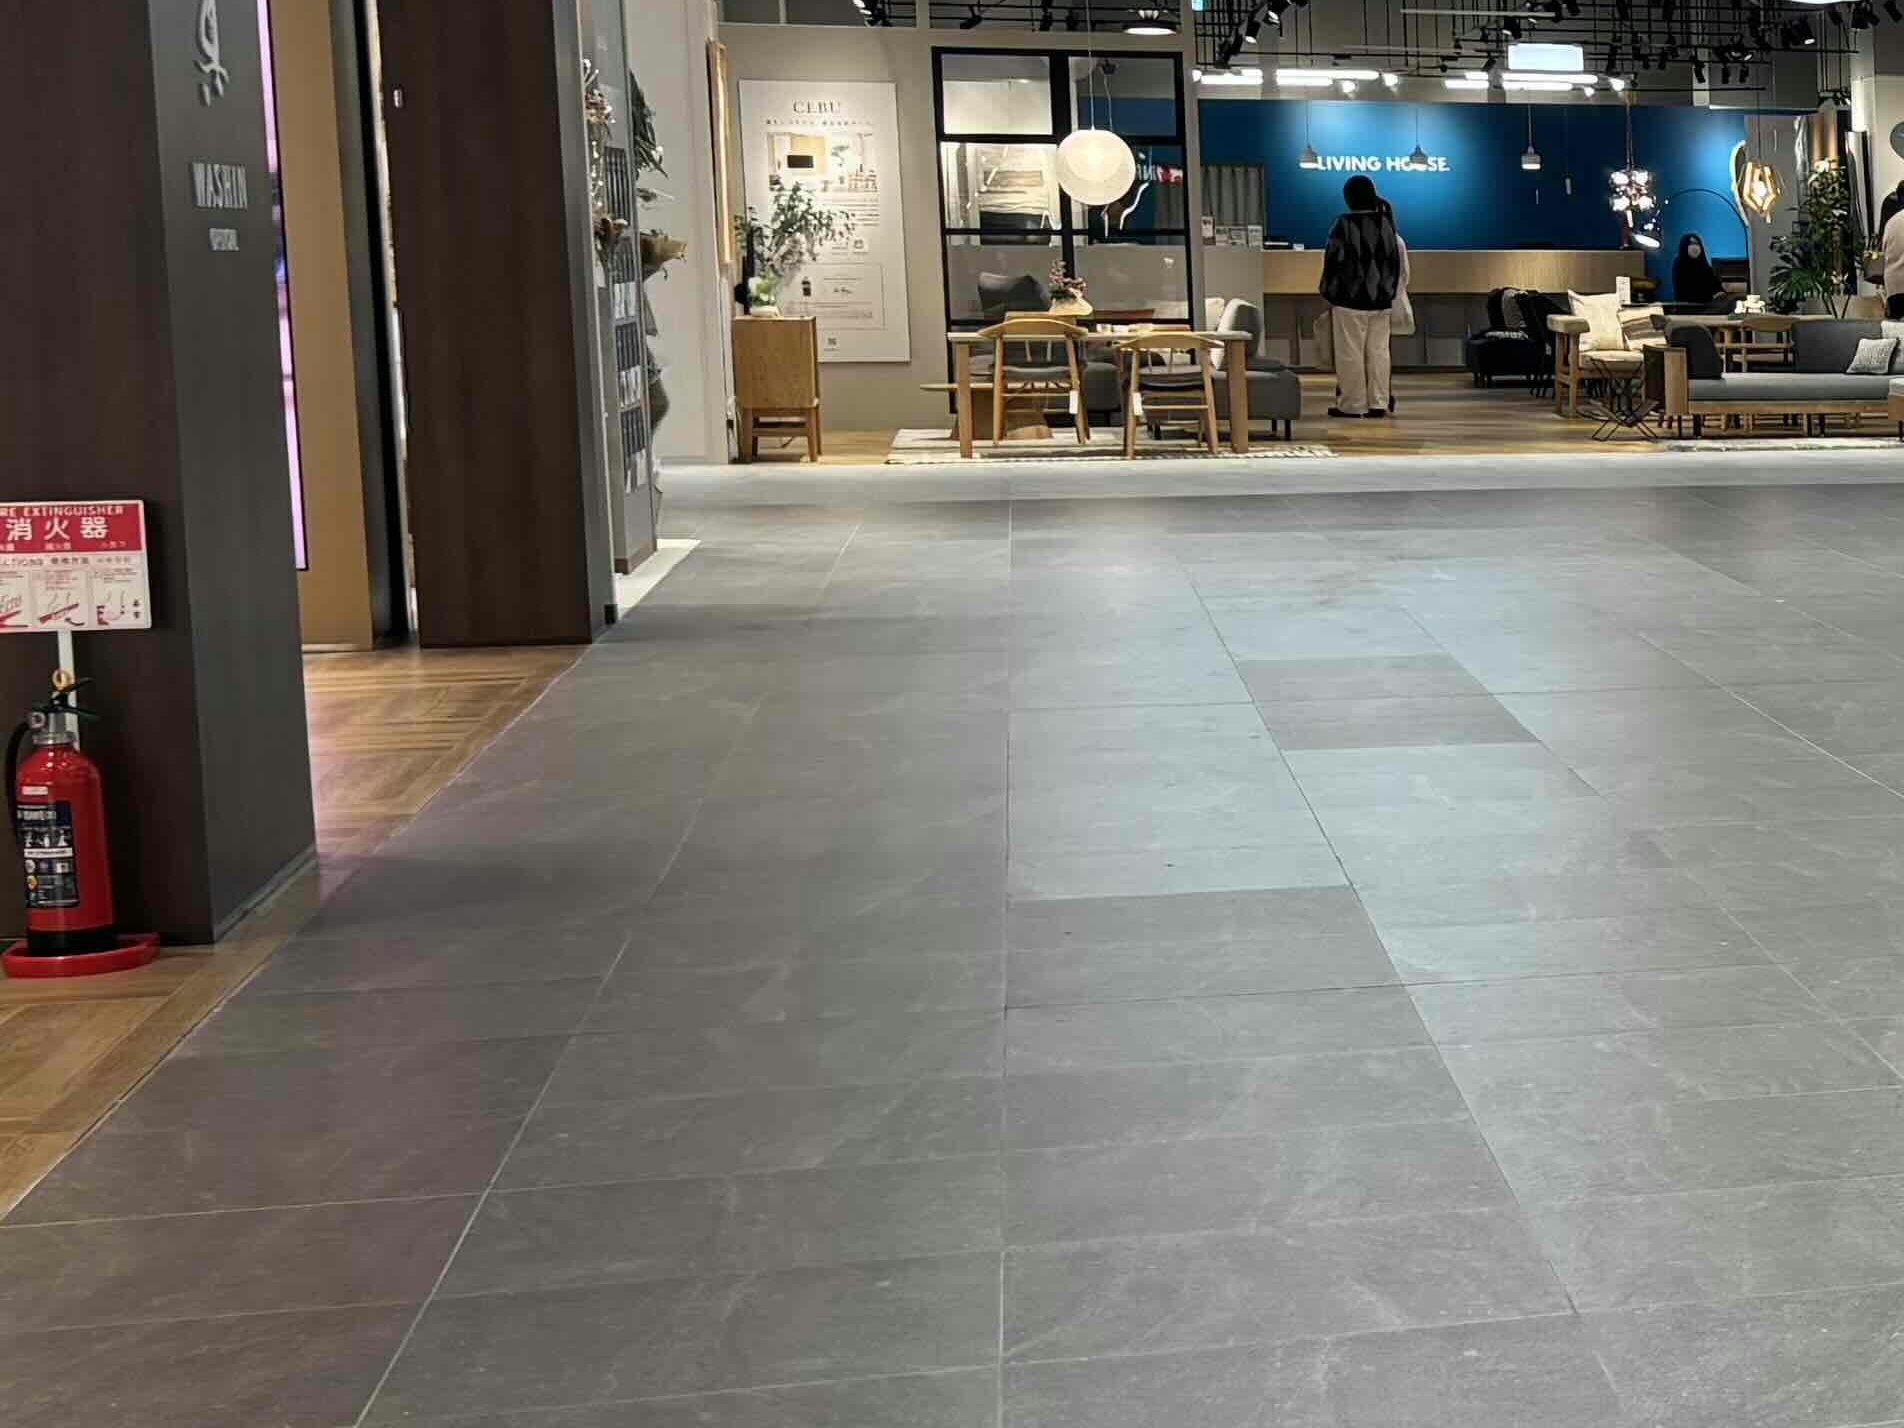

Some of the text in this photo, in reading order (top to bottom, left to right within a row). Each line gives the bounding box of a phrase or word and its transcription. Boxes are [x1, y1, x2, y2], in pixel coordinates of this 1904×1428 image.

[1317, 155, 1382, 172] LIVING
[192, 162, 248, 209] WASHIN
[23, 506, 124, 517] EXTINGUISHER
[5, 516, 108, 541] 消火器
